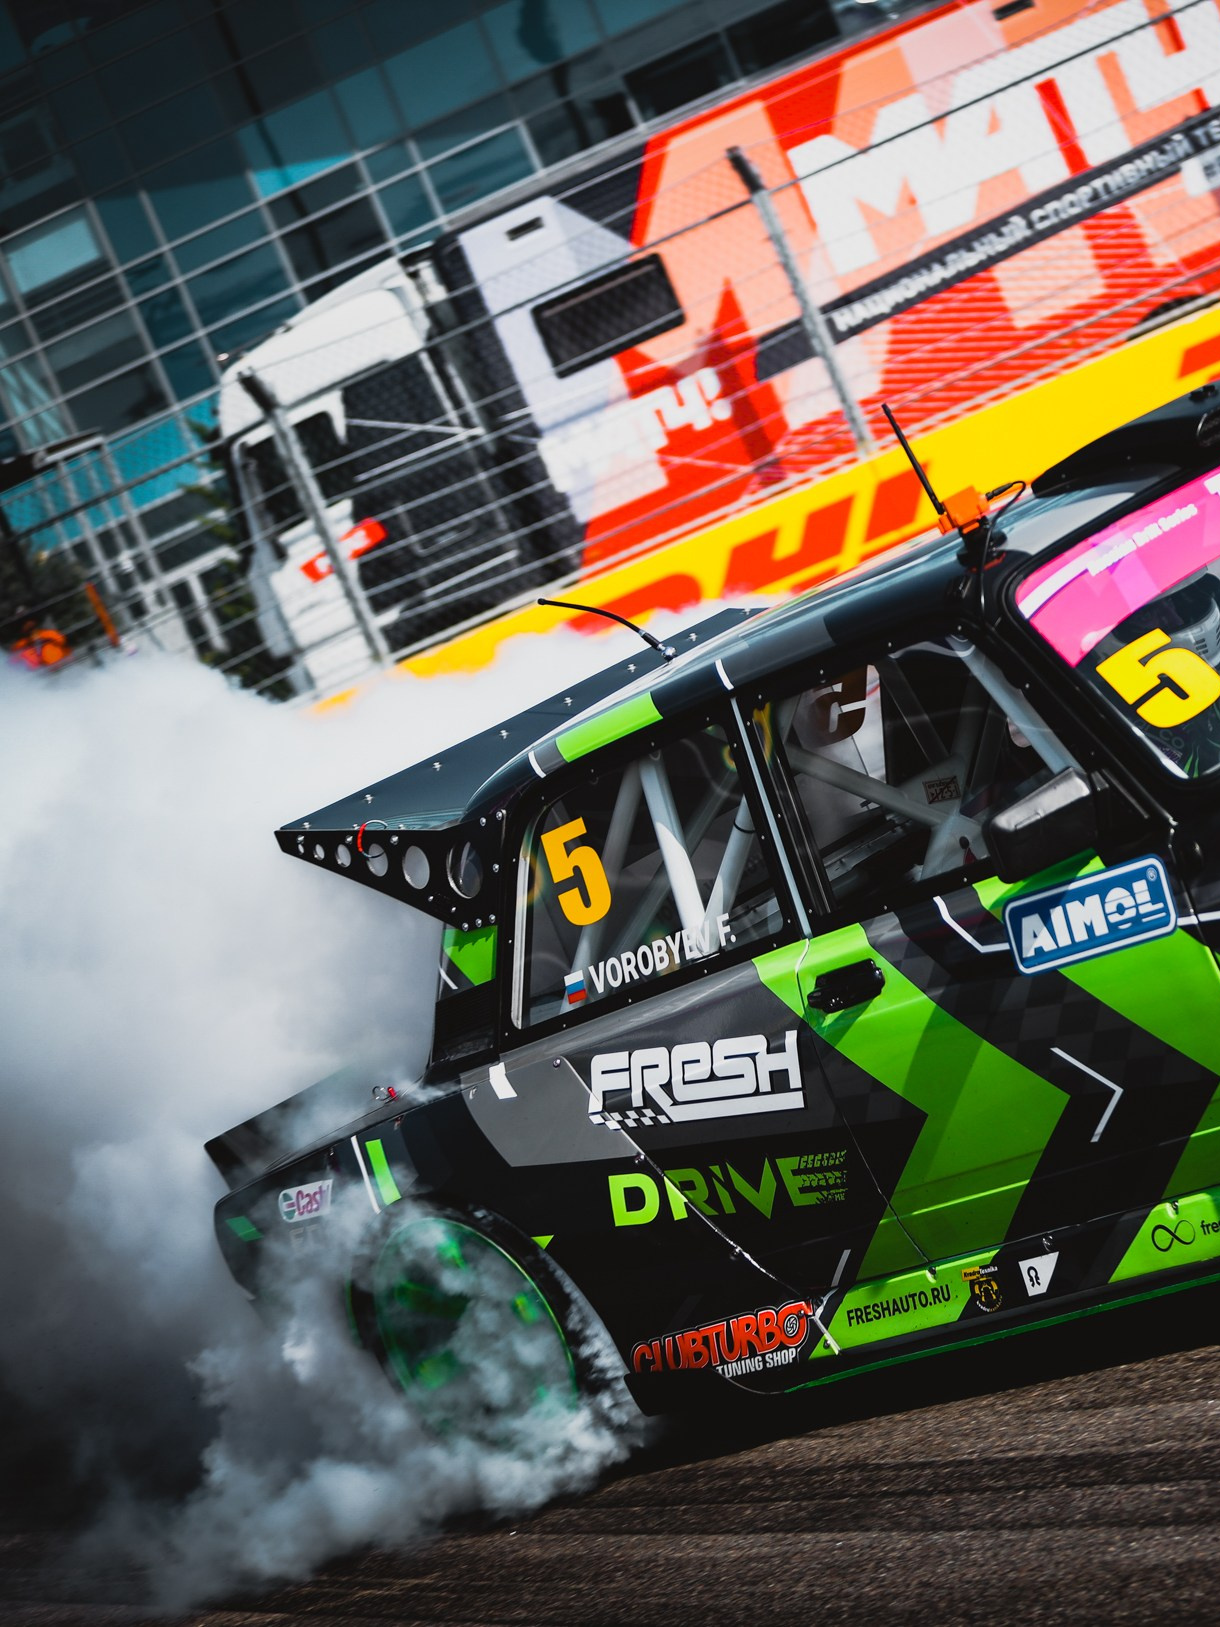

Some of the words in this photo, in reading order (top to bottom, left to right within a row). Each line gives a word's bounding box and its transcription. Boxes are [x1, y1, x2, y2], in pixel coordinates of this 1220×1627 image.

[1031, 132, 1196, 231] СПОРТИВНЫЙ
[1158, 504, 1198, 532] Series
[540, 818, 612, 926] 5
[608, 1150, 848, 1227] DRIVE
[632, 1301, 813, 1374] CLUBTURBO
[846, 1284, 951, 1327] FRESHAUTO.RU
[716, 1356, 764, 1379] TUNING
[765, 1347, 797, 1369] SHOP
